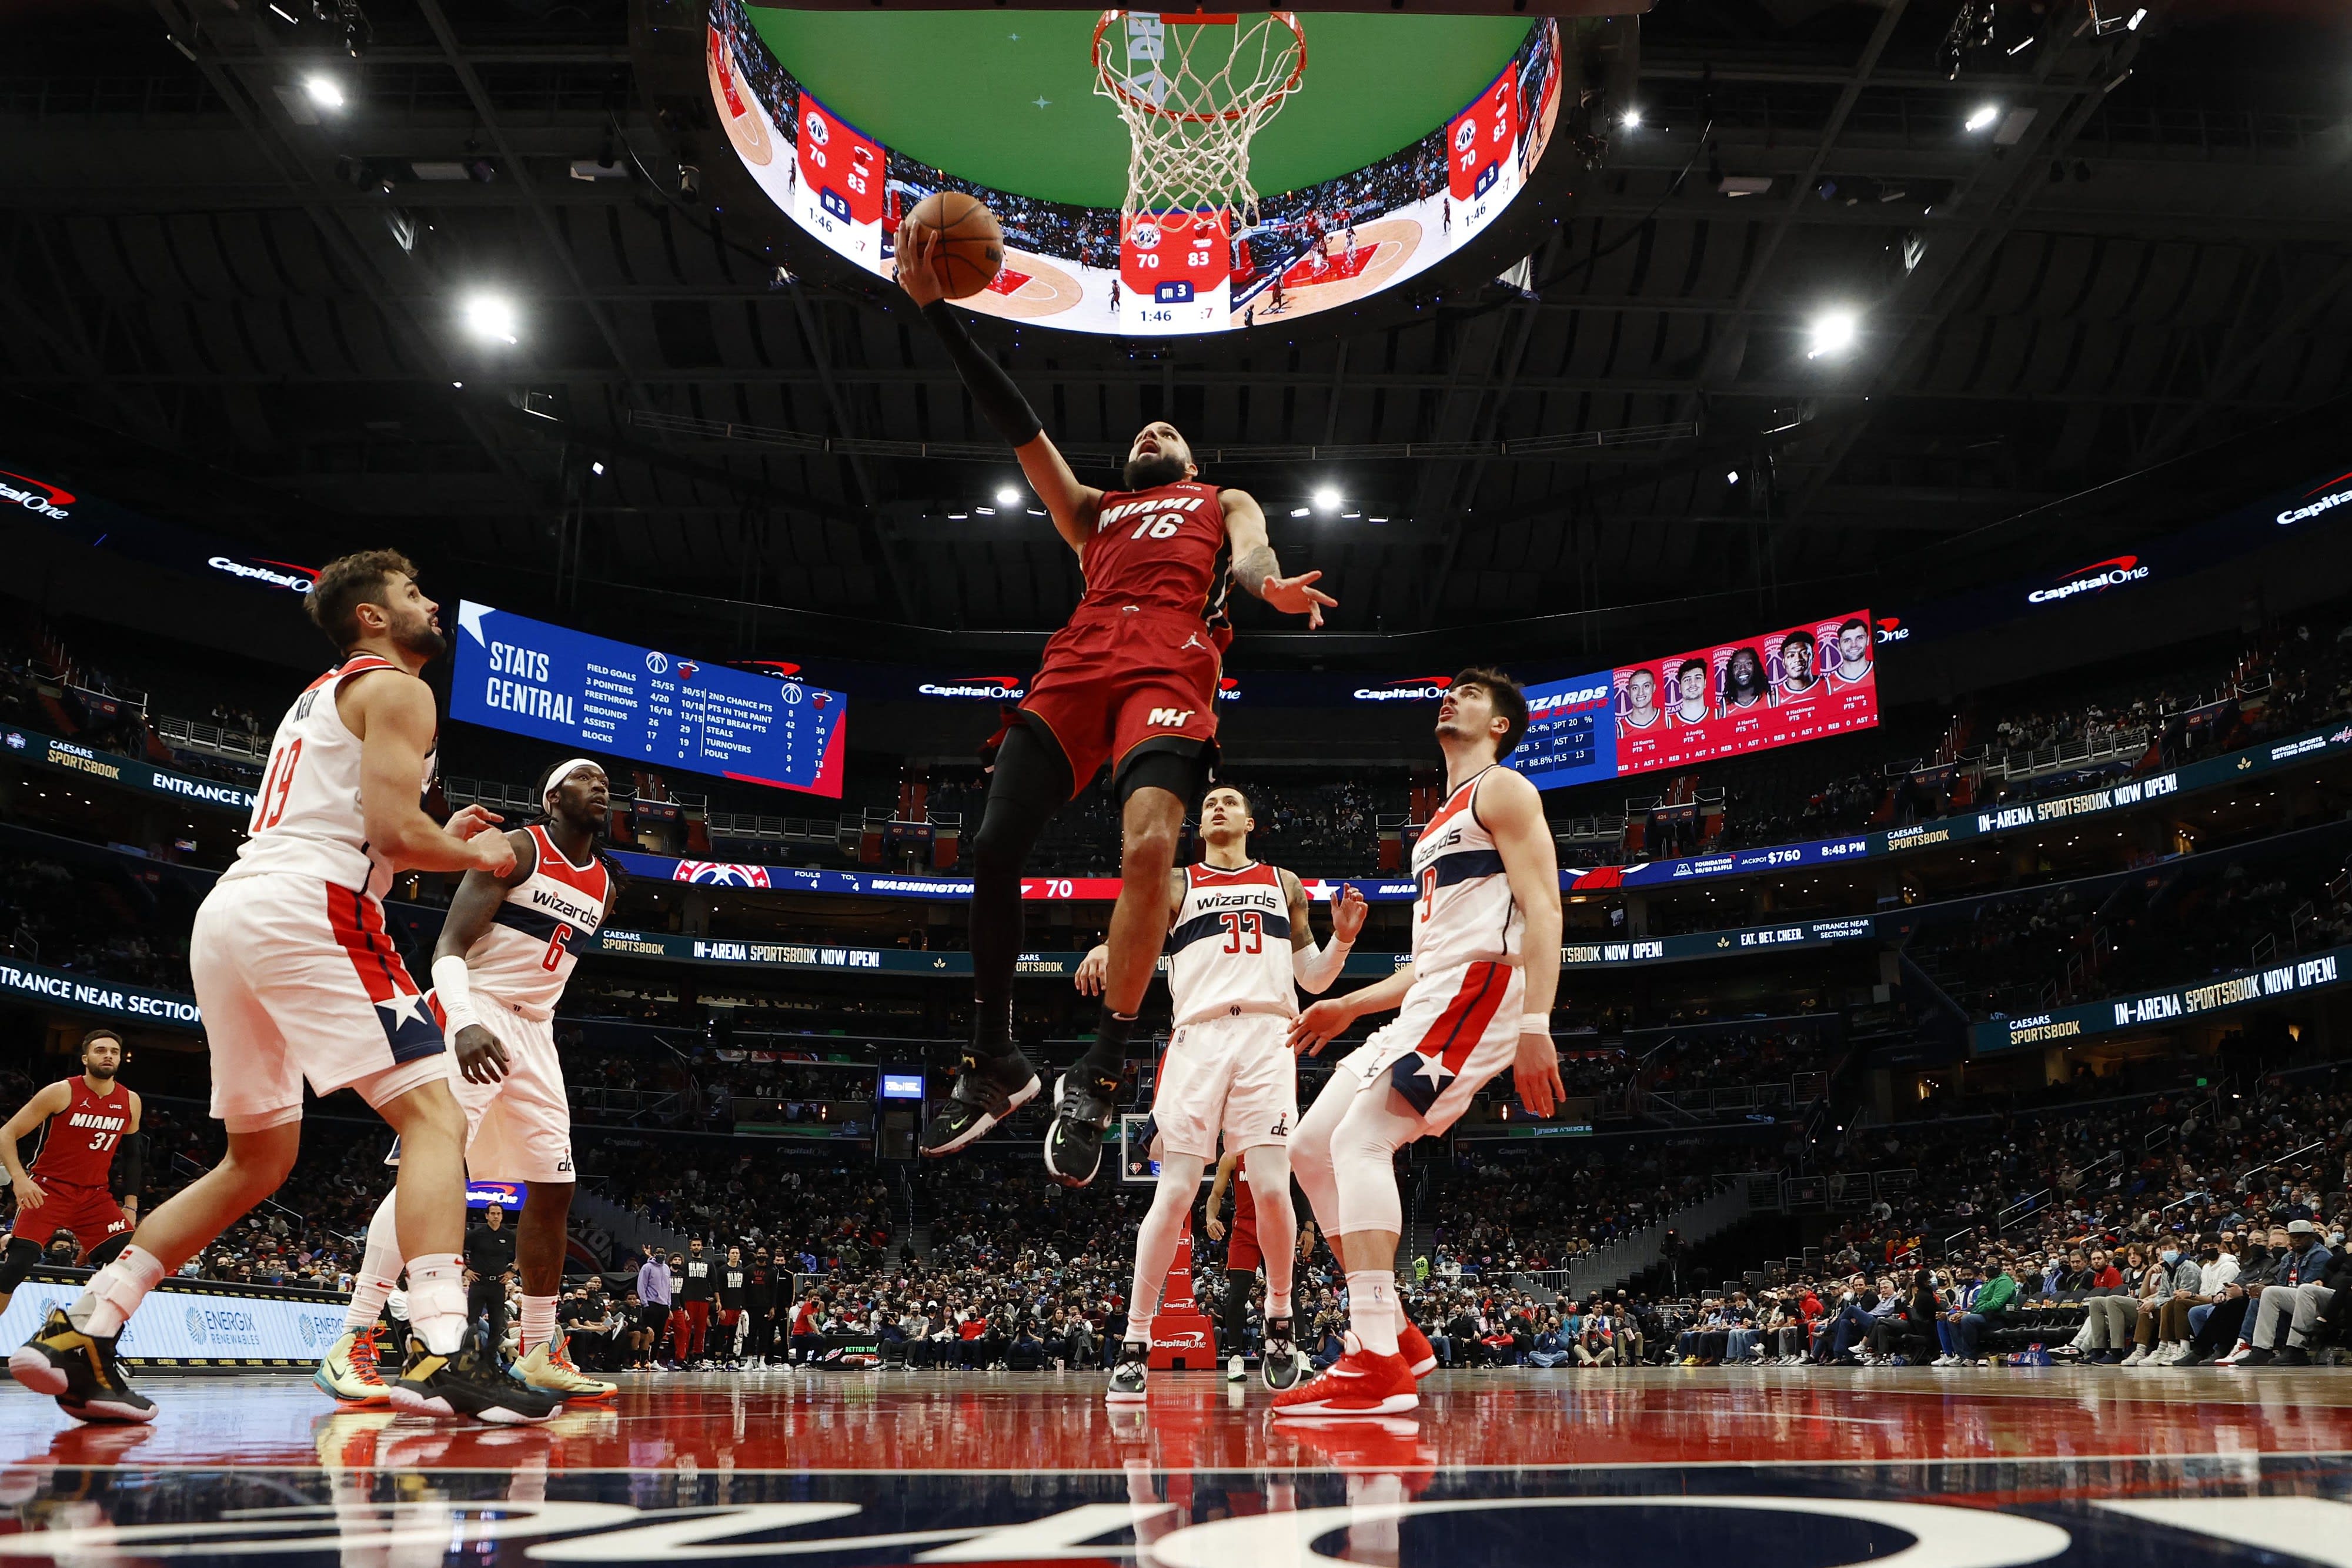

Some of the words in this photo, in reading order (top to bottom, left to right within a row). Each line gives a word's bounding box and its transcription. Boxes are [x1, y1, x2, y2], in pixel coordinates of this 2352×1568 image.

[1494, 118, 1506, 142] 83
[809, 143, 827, 168] 70
[1460, 149, 1476, 172] 70
[1488, 166, 1495, 182] 3
[847, 173, 866, 195] 83
[837, 199, 846, 215] 3
[1465, 201, 1486, 227] 1:46
[808, 207, 833, 233] 1:46
[856, 240, 866, 252] :7
[1137, 253, 1160, 268] 70
[1187, 251, 1210, 266] 83
[1177, 284, 1187, 297] 3
[1140, 310, 1172, 322] 1:46
[1200, 307, 1214, 319] :7
[0, 482, 69, 520] talOne
[2276, 488, 2352, 525] Capita
[1098, 496, 1205, 535] MIAMI
[1130, 512, 1185, 540] 16
[208, 556, 313, 594] CapitalO
[489, 641, 550, 683] STATS
[587, 663, 609, 675] FIELD
[610, 669, 637, 681] GOALS
[593, 678, 634, 695] POINTERS
[650, 679, 675, 691] 25/55
[681, 686, 704, 698] 30/51
[1354, 686, 1449, 701] CapitalOn
[486, 677, 576, 726] CENTRAL
[584, 689, 638, 708] FREETHROWS
[650, 693, 670, 703] 4/20
[681, 699, 704, 711] 10/18
[708, 691, 725, 701] 2ND
[726, 696, 757, 709] CHANCE
[759, 703, 773, 713] PTS
[1525, 686, 1608, 712] IZARDS
[583, 704, 628, 720] REBOUNDS
[649, 704, 673, 717] 16/18
[707, 703, 722, 713] PTS
[723, 707, 731, 716] IN
[733, 709, 749, 720] THE
[750, 712, 773, 724] PAINT
[1553, 698, 1609, 717] STATS
[583, 717, 616, 730] ASSISTS
[648, 718, 659, 727] 26
[680, 711, 703, 723] 13/15
[707, 714, 726, 725] FAST
[726, 718, 751, 731] BREAK
[753, 724, 767, 734] PTS
[785, 720, 796, 729] 42
[818, 715, 823, 723] 7
[680, 724, 690, 733] 29
[706, 726, 734, 738] STEALS
[816, 727, 826, 735] 30
[1527, 724, 1550, 734] 45.4%
[1553, 720, 1566, 730] 3PT
[1568, 718, 1578, 727] 20
[582, 730, 613, 743] BLOCKS
[647, 731, 657, 740] 17
[679, 737, 690, 747] 19
[1515, 744, 1529, 753] REB
[1534, 742, 1540, 750] 5
[1553, 737, 1568, 747] AST
[1575, 734, 1584, 743] 17
[49, 740, 93, 759] CAESARS
[646, 744, 652, 752] 0
[706, 737, 752, 754] TURNOVERS
[2271, 743, 2298, 755] OFFICIAL
[2298, 735, 2324, 747] SPORTS
[2272, 750, 2298, 761] BETTING
[2298, 741, 2327, 754] PARTNER
[678, 750, 684, 758] 0
[704, 748, 729, 760] FOULS
[1515, 760, 1525, 768] FT
[1529, 756, 1552, 767] 88.8%
[1553, 754, 1567, 763] FLS
[1575, 750, 1585, 759] 13
[47, 749, 120, 780] SPORTSBOOK
[786, 765, 791, 773] 4
[814, 760, 824, 768] 13
[815, 771, 821, 779] 3
[152, 772, 241, 805] ENTRANCE
[252, 737, 302, 833] 19
[1978, 805, 2034, 833] IN-ARENA
[2037, 790, 2112, 822] SPORTSBOOK
[2114, 782, 2141, 806] NOW
[2144, 773, 2179, 800] OPEN!
[1887, 825, 1924, 840] CAESARS
[1888, 829, 1949, 851] SPORTSBOOK
[1741, 856, 1767, 865] JACKPOT
[1768, 849, 1801, 865] $760
[1822, 845, 1847, 856] 8:48
[1849, 841, 1866, 852] PM
[1695, 858, 1732, 868] FOUNDATION
[810, 879, 818, 889] 4
[851, 882, 860, 892] 4
[1045, 880, 1073, 898] 70
[1421, 865, 1437, 924] 9
[1219, 911, 1264, 955] 33
[1813, 922, 1849, 932] ENTRANCE
[1850, 920, 1869, 928] NEAR
[603, 930, 640, 941] CAESARS
[1740, 933, 1757, 947] EAT.
[1759, 932, 1776, 945] BET.
[1777, 928, 1804, 942] CHEER.
[1820, 931, 1848, 940] SECTION
[541, 922, 573, 973] 6
[602, 938, 664, 955] SPORTSBOOK
[693, 941, 747, 961] IN-ARENA
[750, 945, 818, 964] SPORTSBOOK
[821, 949, 846, 966] NOW
[848, 951, 880, 968] OPEN!
[1561, 945, 1602, 963] TSBOOK
[1604, 944, 1630, 961] NOW
[1632, 941, 1663, 959] OPEN!
[1015, 961, 1063, 972] ORTSBOOK
[1, 966, 71, 999] TRANCE
[75, 984, 125, 1011] NEAR
[2114, 994, 2182, 1025] IN-ARENA
[2186, 974, 2260, 1013] SPORTSBOOK
[2263, 966, 2294, 995] NOW
[2297, 955, 2338, 987] OPEN!
[2009, 1014, 2050, 1030] CAESARS
[2010, 1021, 2081, 1045] SPORTSBOOK
[69, 1112, 125, 1131] MIAMI
[88, 1132, 118, 1152] 31
[1416, 1260, 1425, 1268] 66
[206, 1310, 256, 1332] ENERGIX
[314, 1317, 343, 1335] ENERG
[212, 1333, 260, 1345] RENEWABLES
